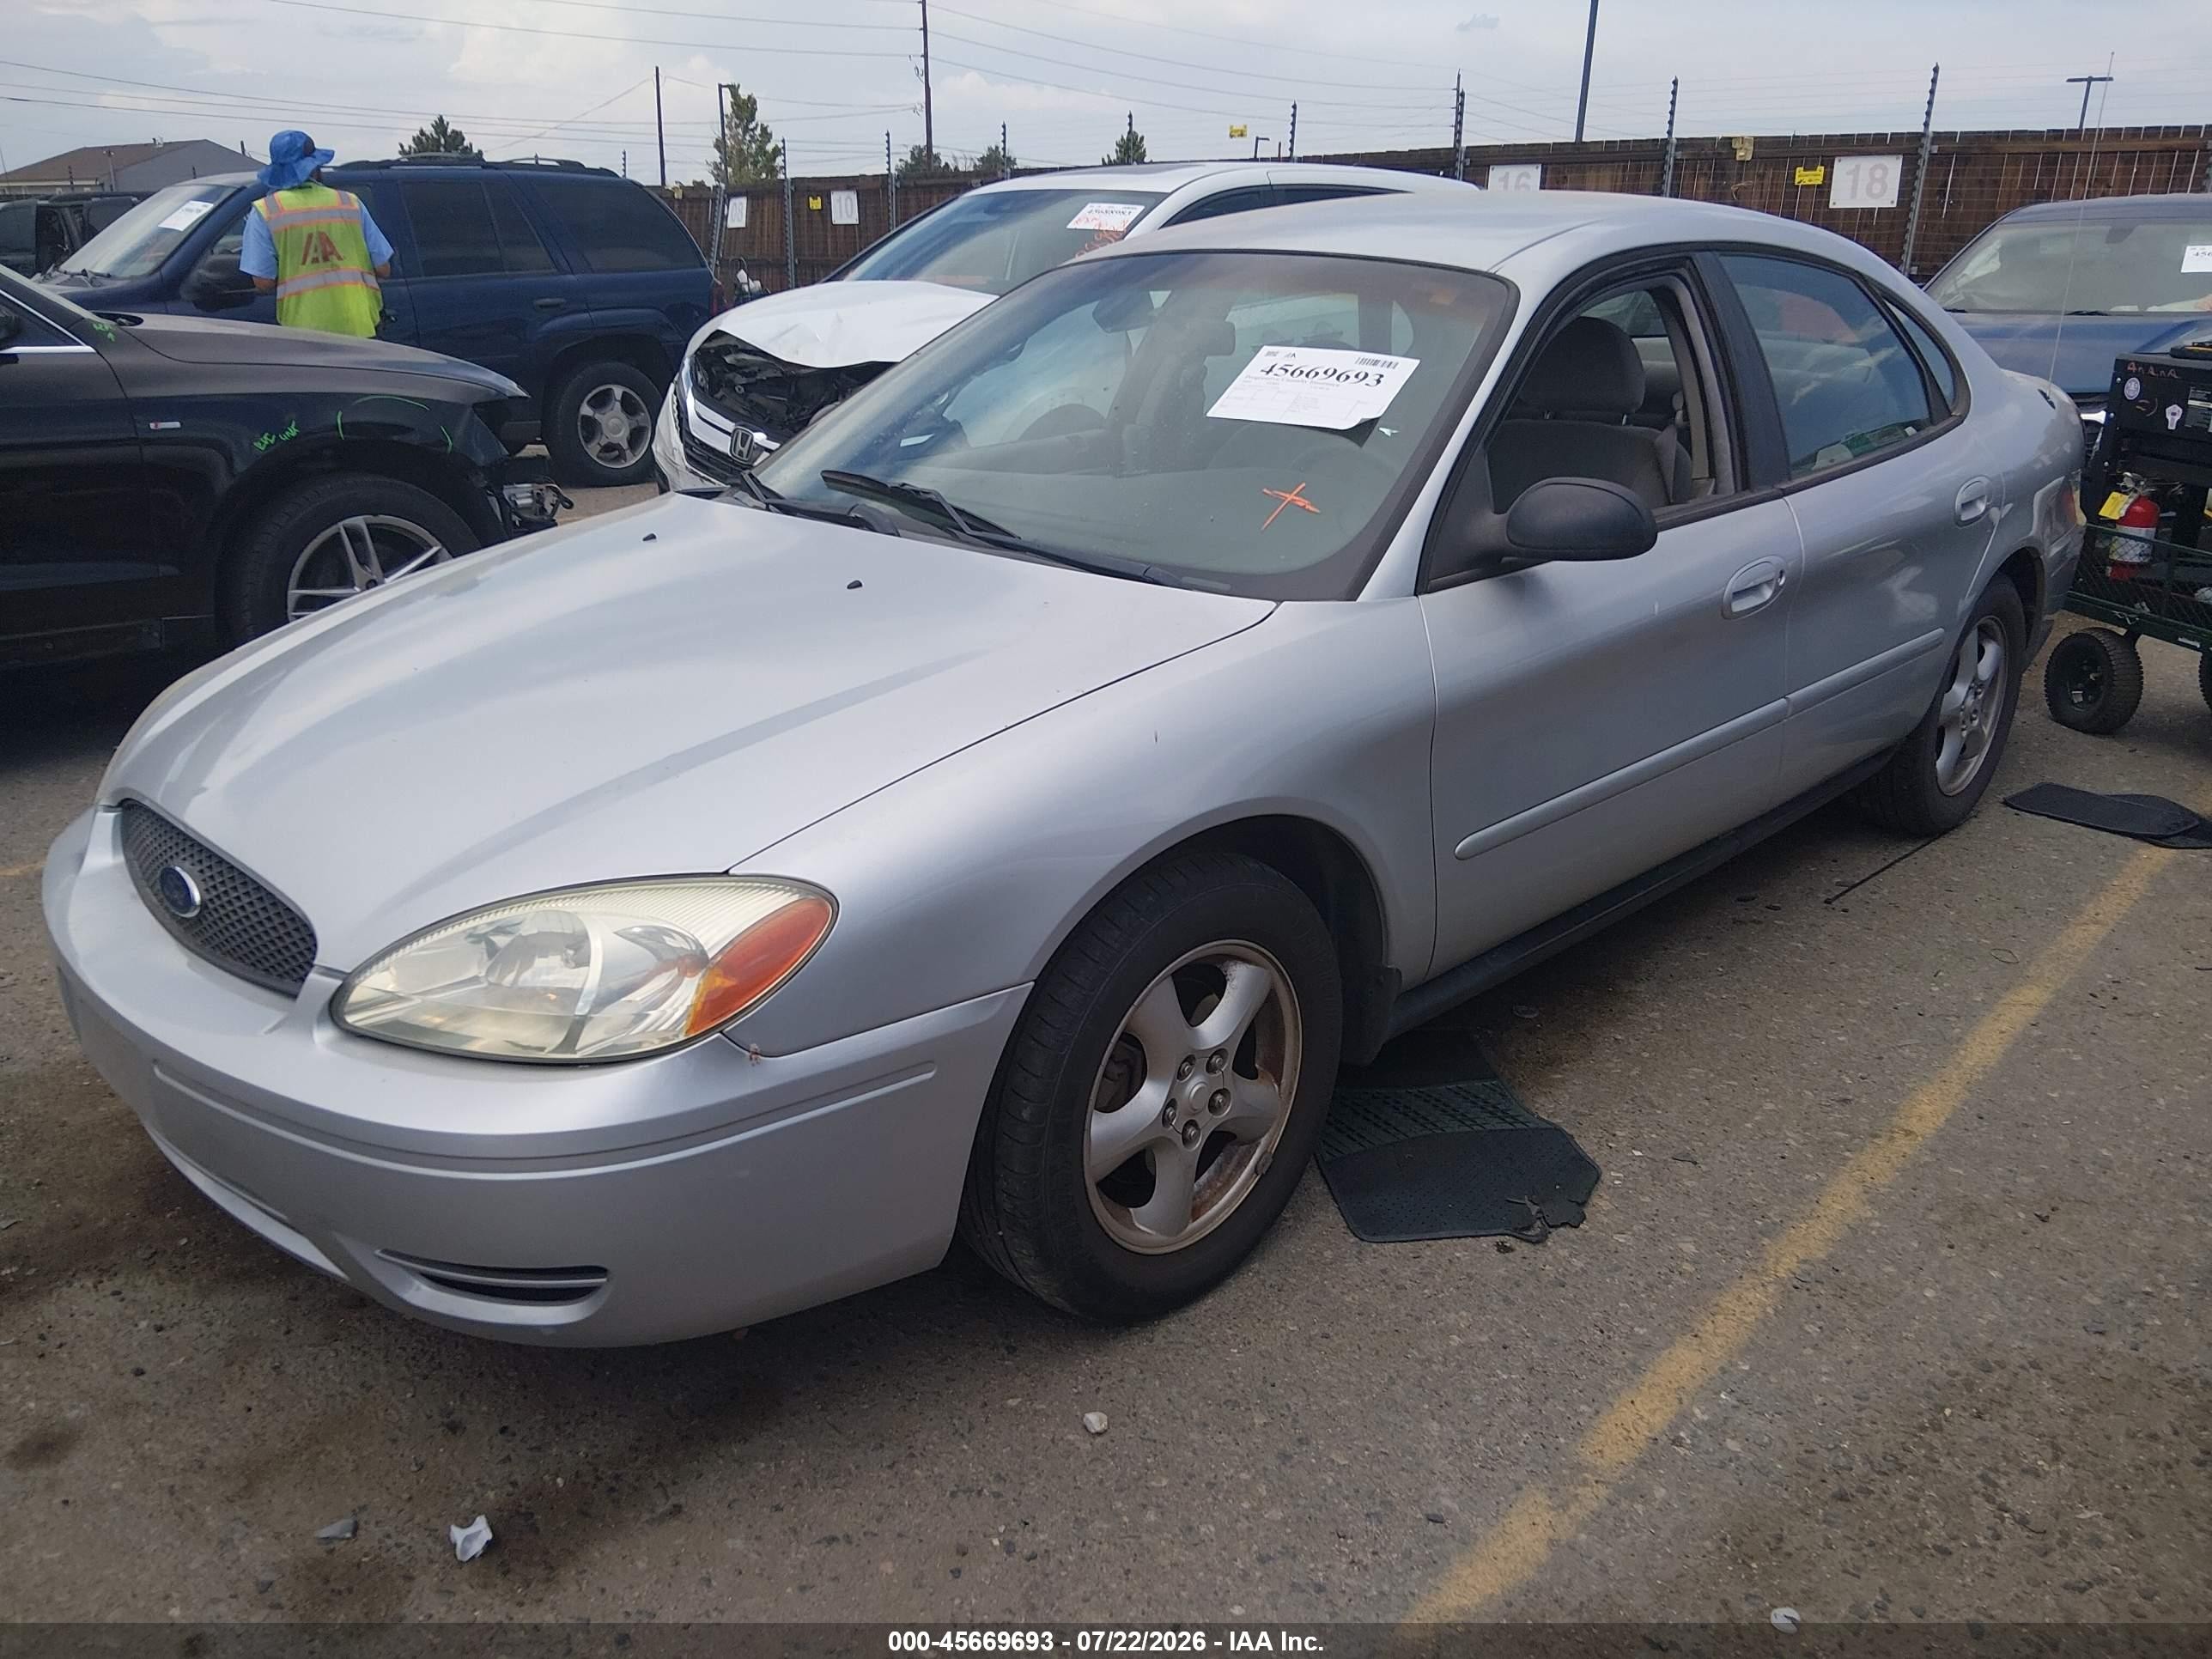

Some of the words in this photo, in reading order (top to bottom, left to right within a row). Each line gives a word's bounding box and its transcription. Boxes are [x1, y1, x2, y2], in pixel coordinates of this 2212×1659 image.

[1845, 162, 1889, 200] 18
[837, 196, 854, 219] 10
[1260, 362, 1385, 387] 45669693
